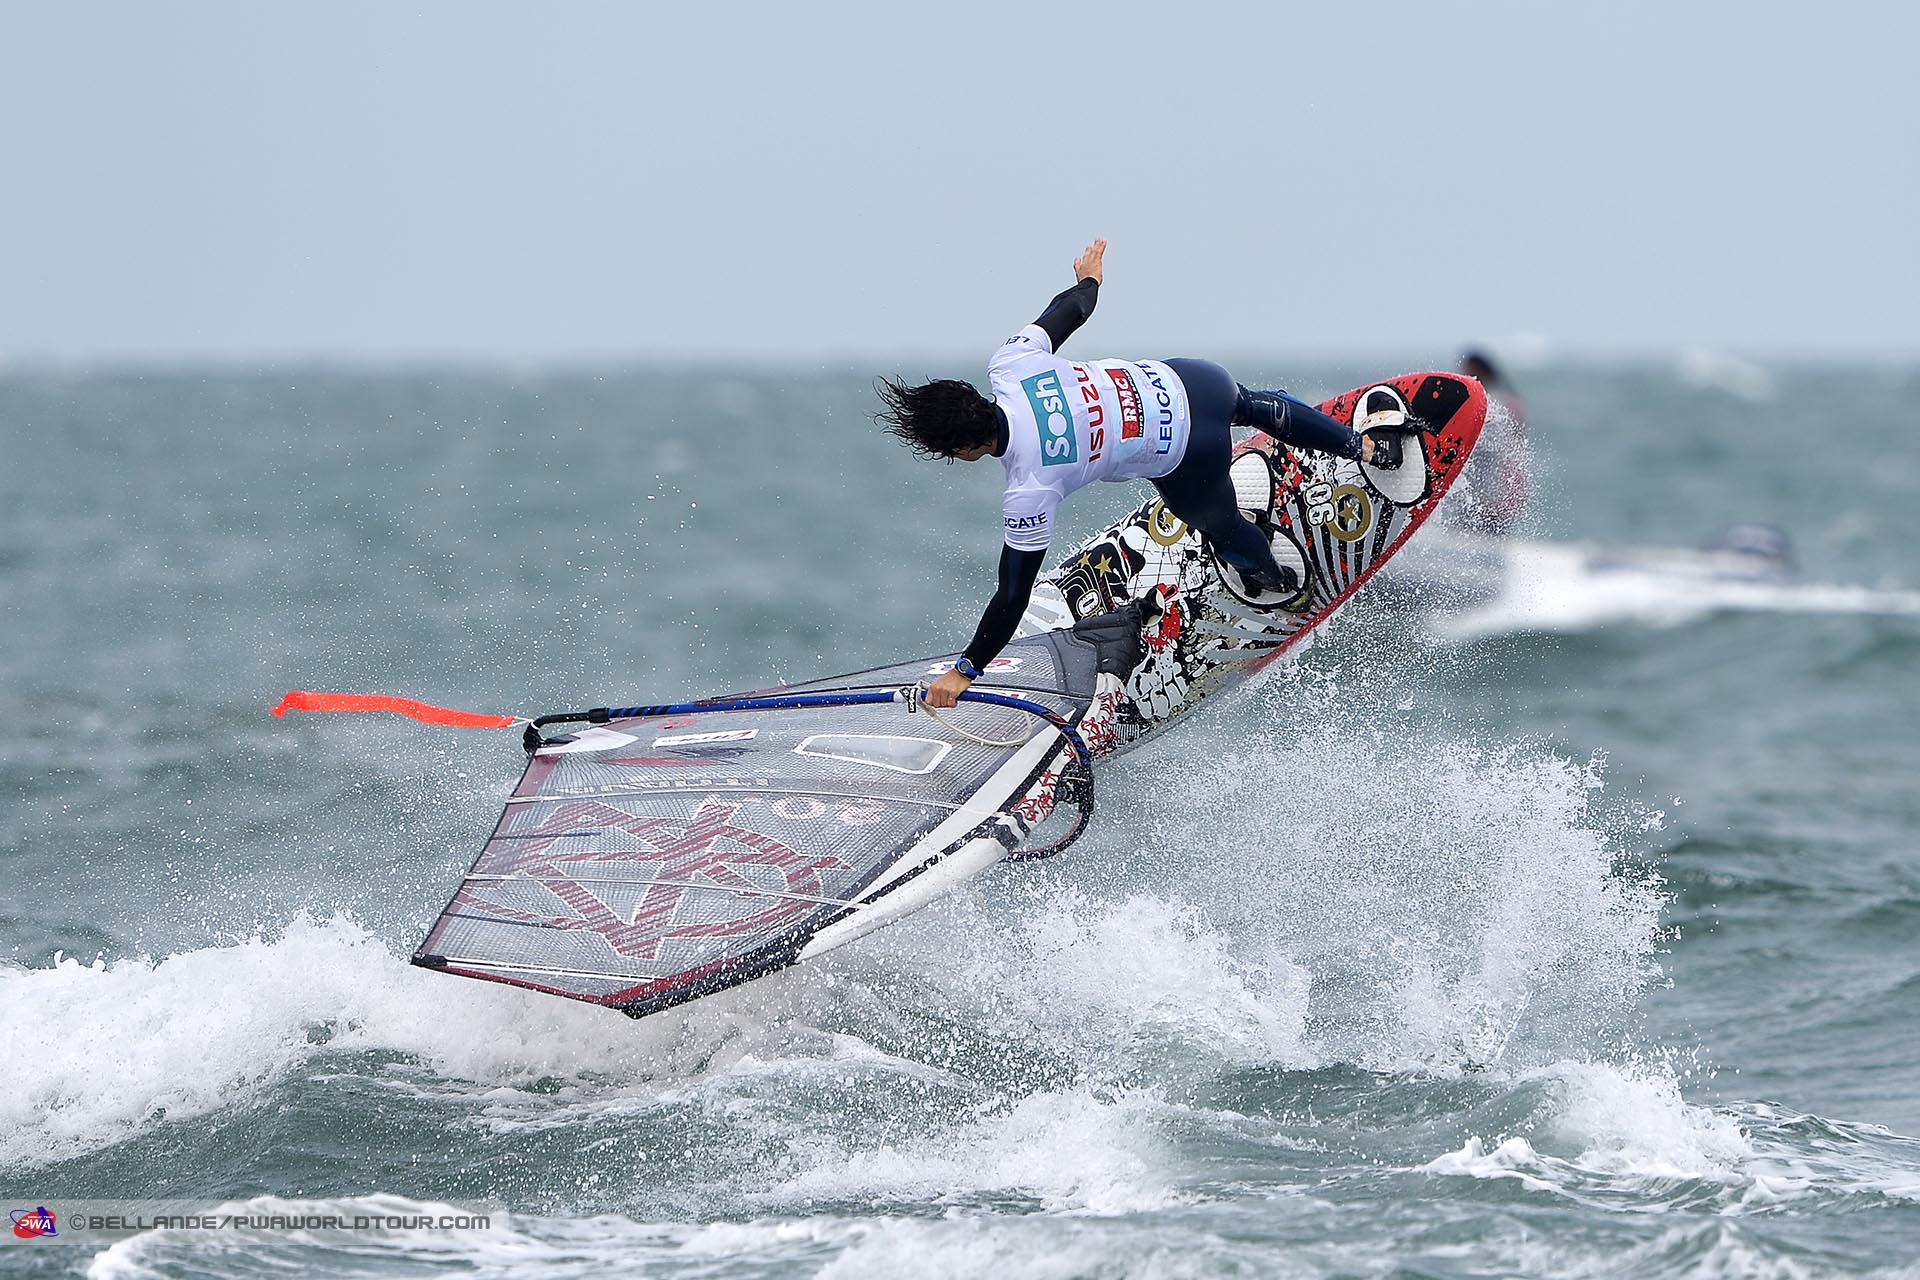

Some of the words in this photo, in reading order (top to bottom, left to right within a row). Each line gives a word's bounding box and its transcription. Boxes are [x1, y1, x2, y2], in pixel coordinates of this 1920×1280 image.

[1073, 366, 1106, 463] ISUZU
[1114, 377, 1138, 422] RMC
[1133, 362, 1173, 455] LEUCATE
